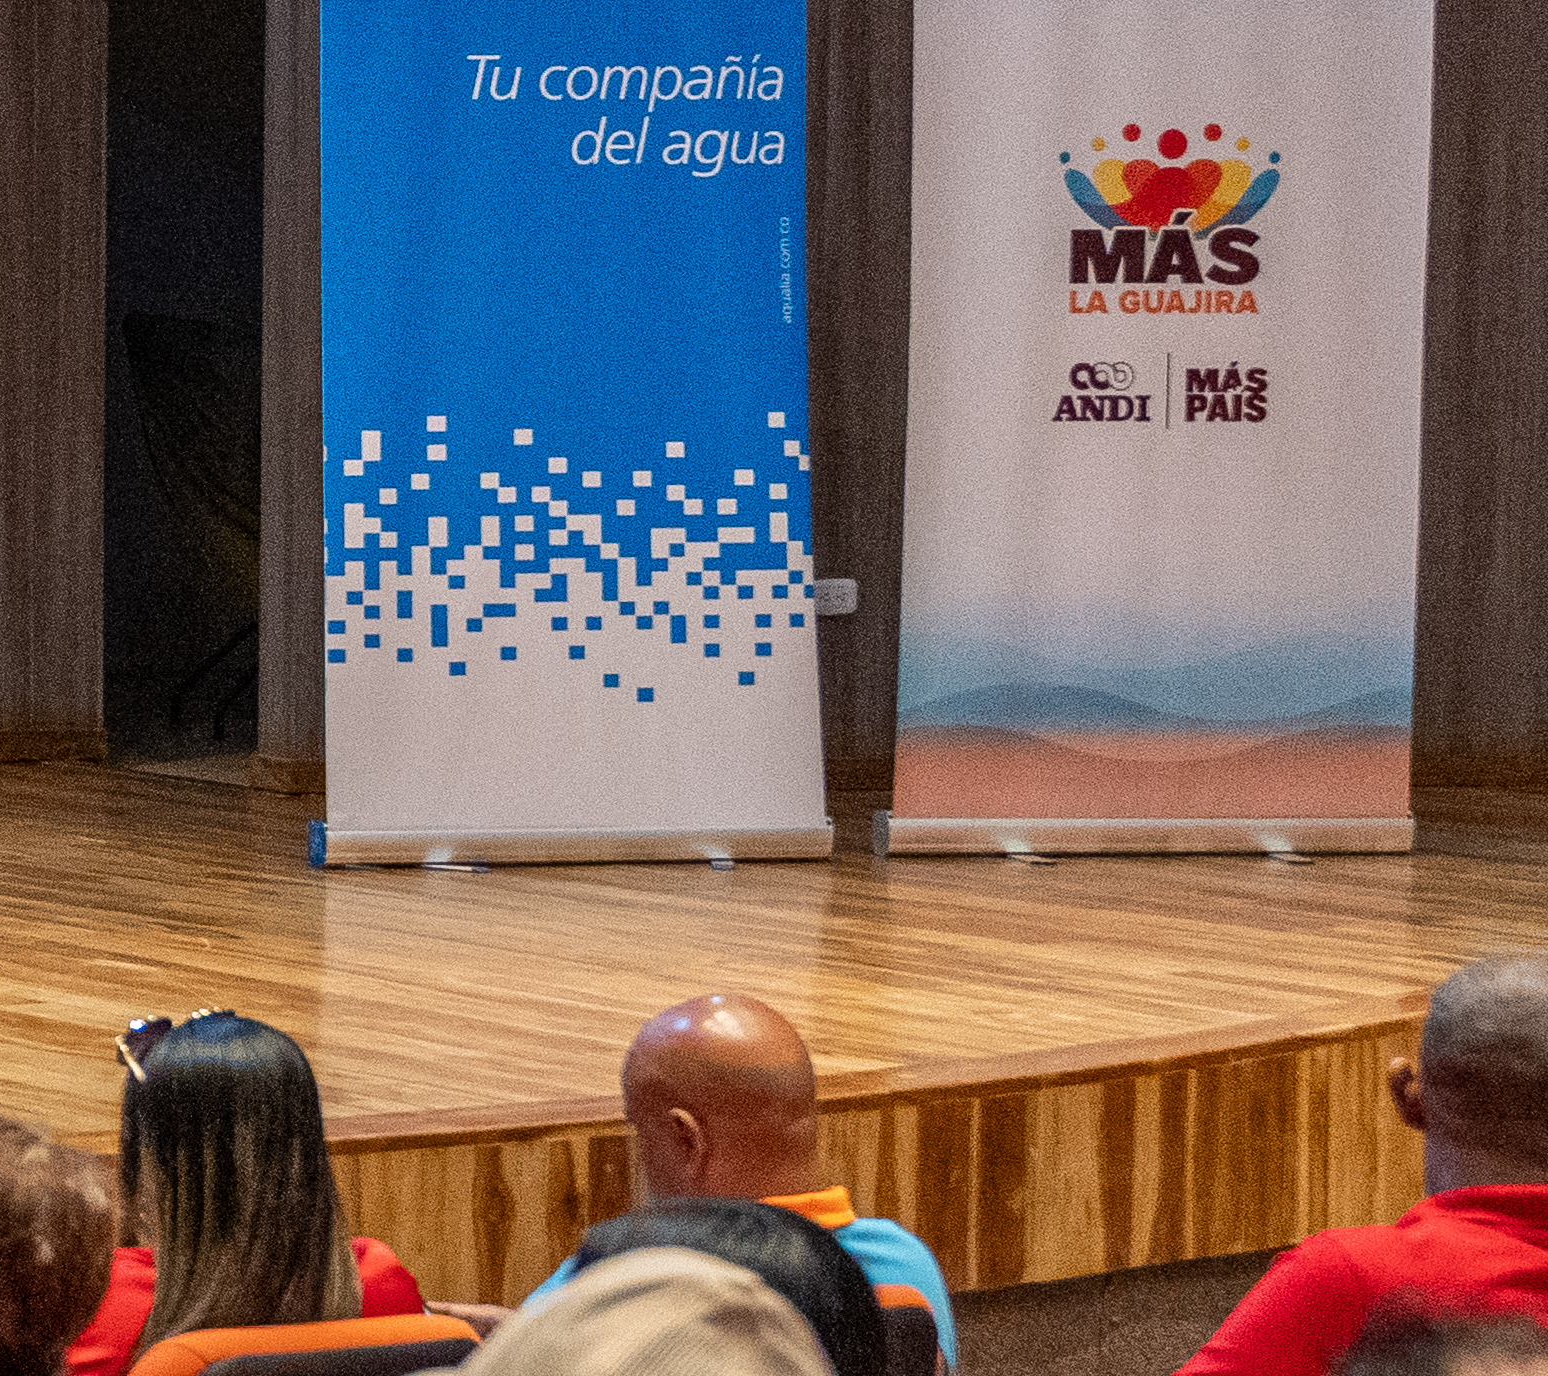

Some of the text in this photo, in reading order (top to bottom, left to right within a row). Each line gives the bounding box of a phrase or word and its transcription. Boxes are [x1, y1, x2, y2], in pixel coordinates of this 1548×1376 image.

[466, 52, 784, 113] Tu compañía
[571, 116, 785, 178] del agua
[1069, 210, 1261, 286] MÁS
[1068, 289, 1259, 315] LA GUAJIRA
[1184, 360, 1268, 394] MÁS
[1052, 394, 1152, 423] ANDI
